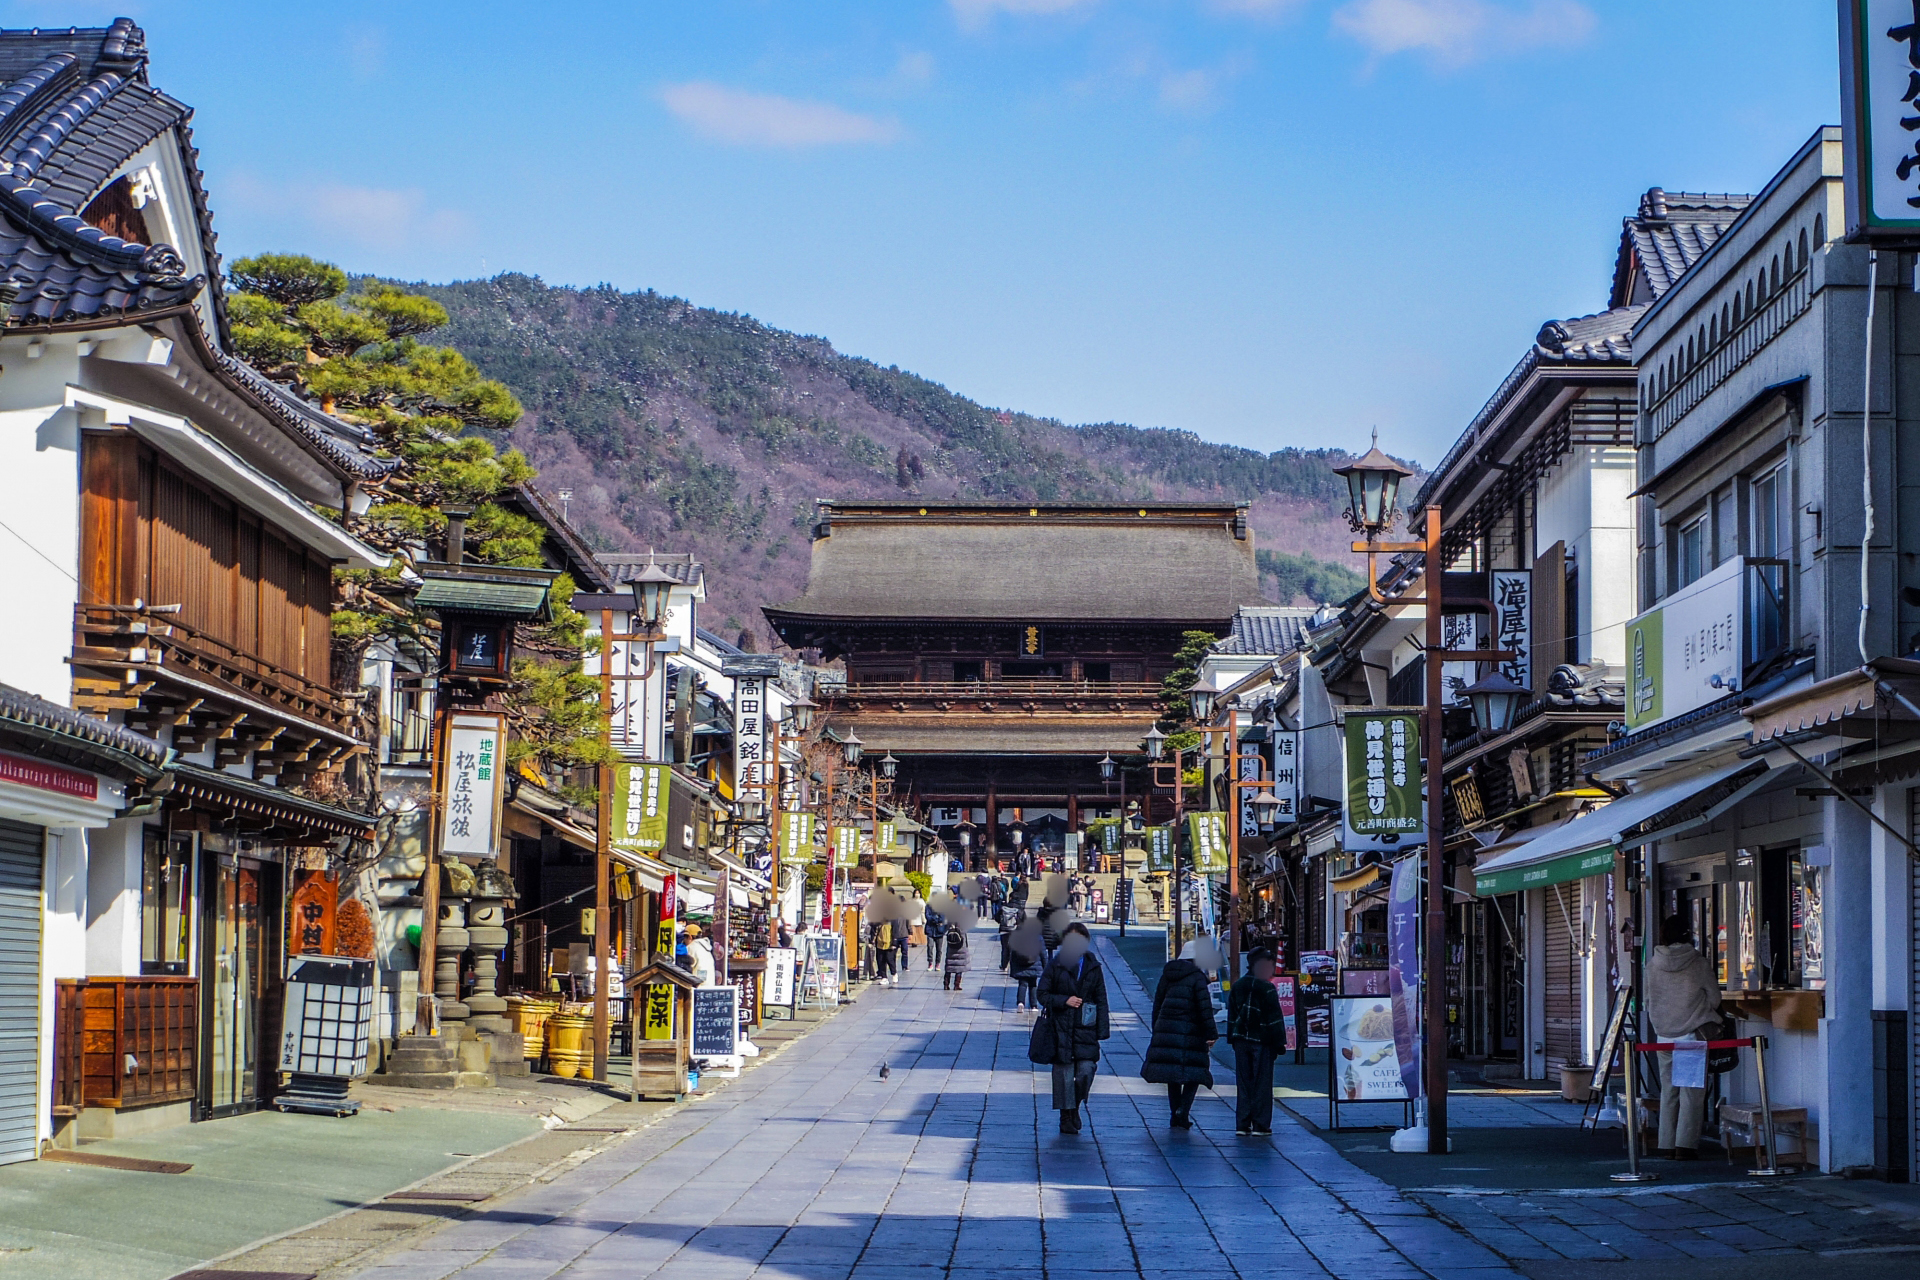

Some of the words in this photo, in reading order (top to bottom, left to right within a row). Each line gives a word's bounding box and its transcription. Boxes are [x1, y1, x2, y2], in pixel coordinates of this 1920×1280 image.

[470, 633, 487, 660] 松屋
[739, 677, 760, 797] 高田屋銘産
[1391, 719, 1406, 787] 信州善光寺
[477, 738, 493, 781] 地蔵館
[1278, 739, 1294, 815] 信州屋
[1365, 720, 1386, 815] 仲見世通り
[774, 963, 784, 1002] 雨宮仏具店
[282, 1031, 295, 1065] 中村屋
[1367, 1080, 1404, 1088] SWEETS
[1373, 1069, 1398, 1077] CAFE
